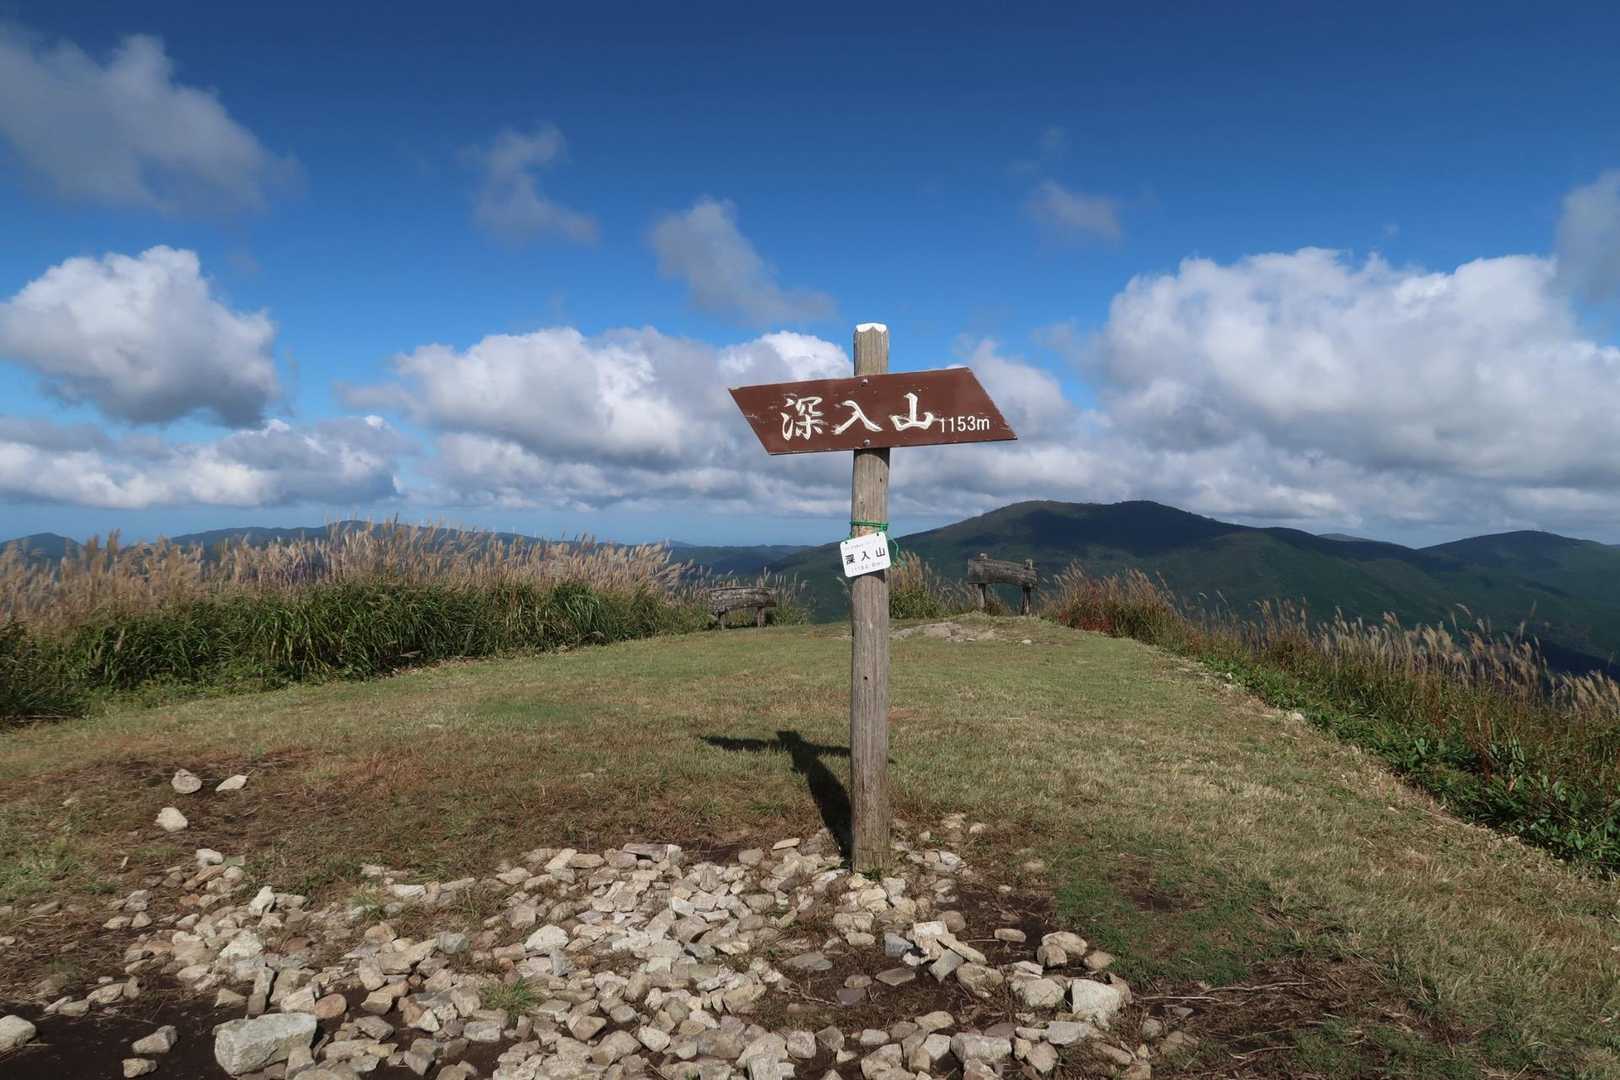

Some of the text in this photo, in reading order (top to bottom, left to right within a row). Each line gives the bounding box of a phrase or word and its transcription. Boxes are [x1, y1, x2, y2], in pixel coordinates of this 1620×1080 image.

[780, 392, 990, 440] 深入山 1153m
